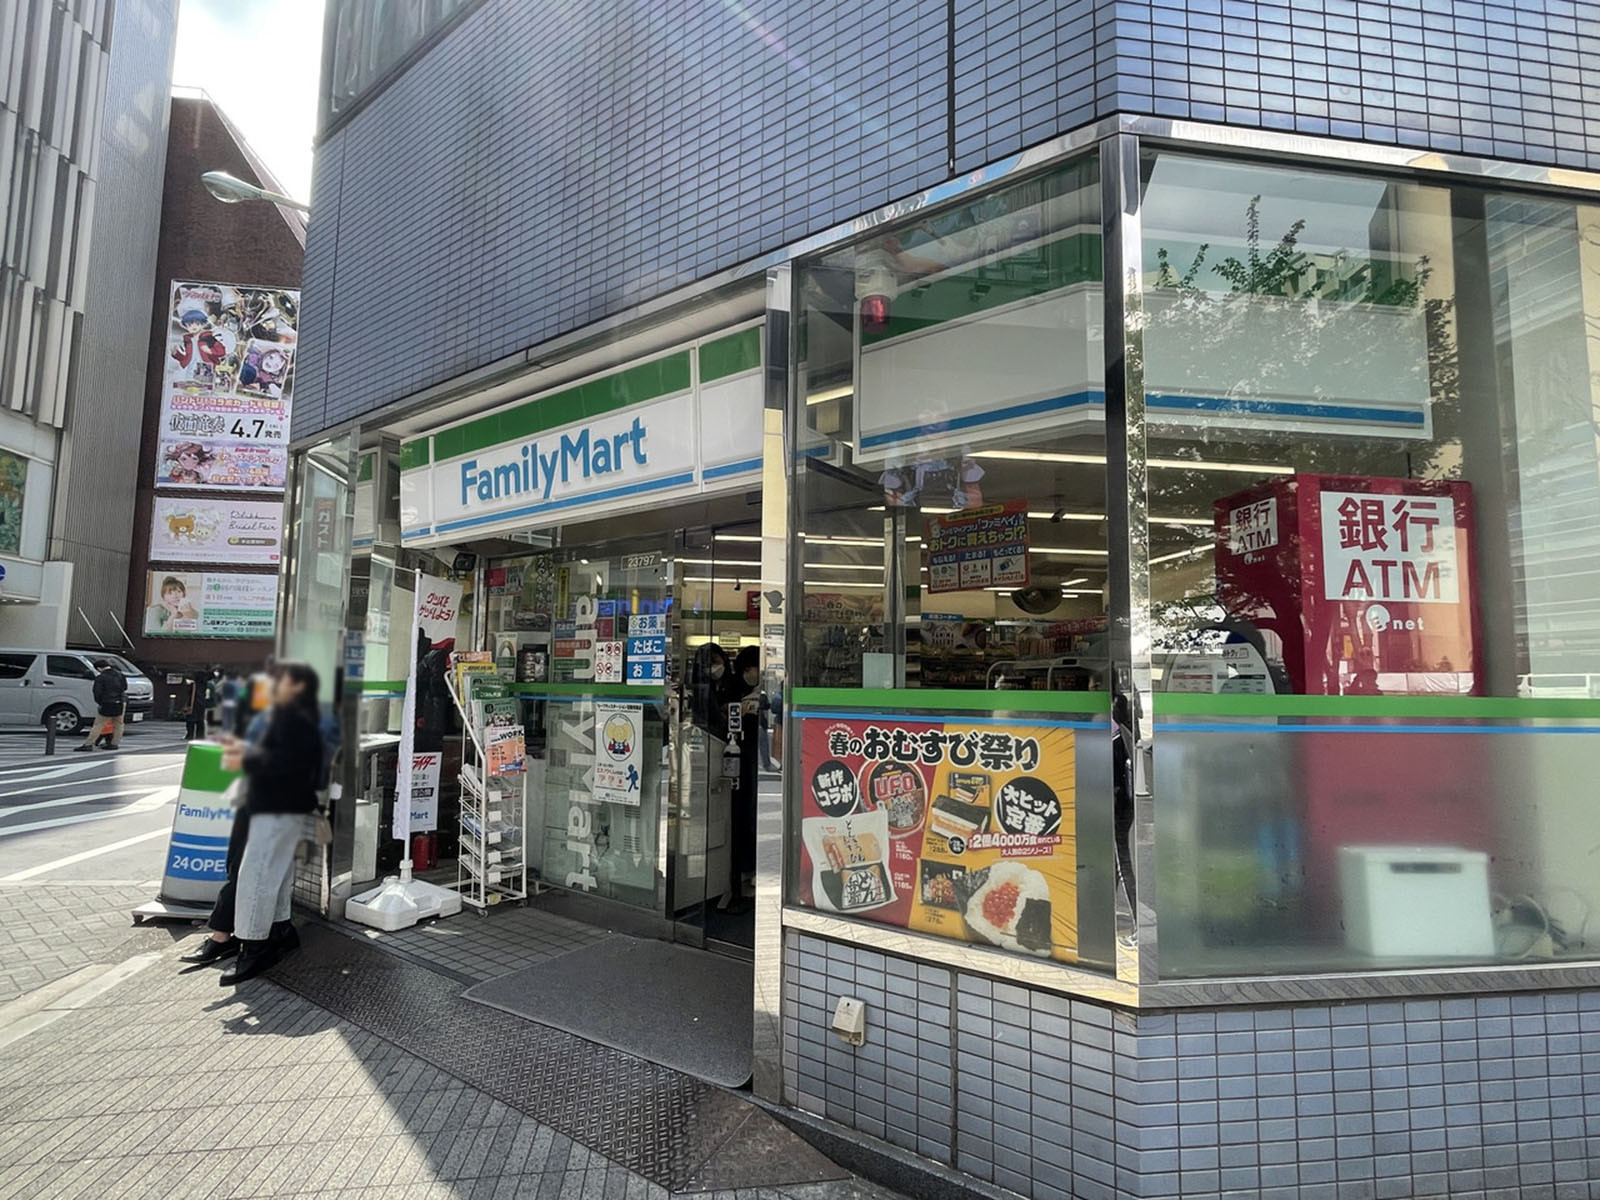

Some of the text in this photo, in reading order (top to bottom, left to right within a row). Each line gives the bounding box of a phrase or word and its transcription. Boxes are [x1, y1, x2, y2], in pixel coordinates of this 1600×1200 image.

[230, 419, 265, 438] 4.7
[460, 417, 648, 505] FamilyMart
[1236, 501, 1271, 532] 銀行
[1338, 497, 1440, 552] 銀行
[1236, 527, 1272, 553] ATM
[627, 555, 656, 568] 23797
[1341, 559, 1441, 599] ATM
[638, 615, 657, 629] お薬
[633, 640, 662, 654] たばこ
[817, 769, 845, 789] 新作
[817, 782, 854, 807] コラボ
[1003, 784, 1058, 818] 大ヒット
[179, 803, 235, 820] FamilyM
[1005, 804, 1046, 835] 定番
